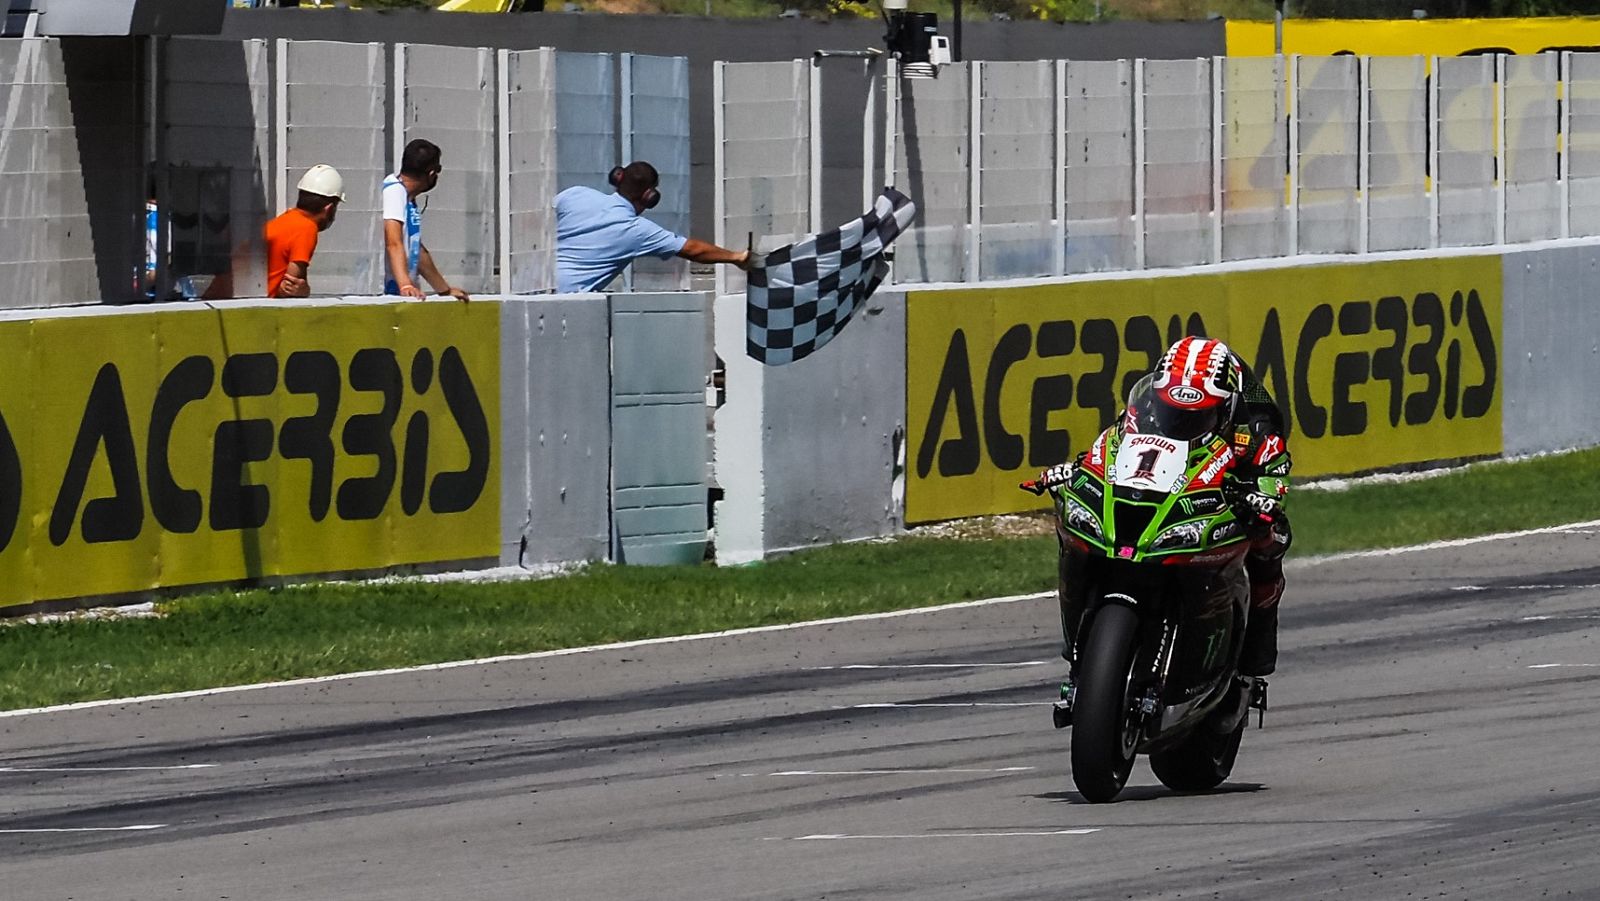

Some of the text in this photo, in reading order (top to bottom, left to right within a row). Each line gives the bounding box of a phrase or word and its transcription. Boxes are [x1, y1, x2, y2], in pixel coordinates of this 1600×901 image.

[1175, 388, 1199, 400] Arai
[48, 345, 490, 547] ACERBIS
[1128, 436, 1177, 454] SHOWA
[1137, 448, 1162, 473] 1
[1170, 475, 1187, 495] elf
[1212, 524, 1228, 540] elf
